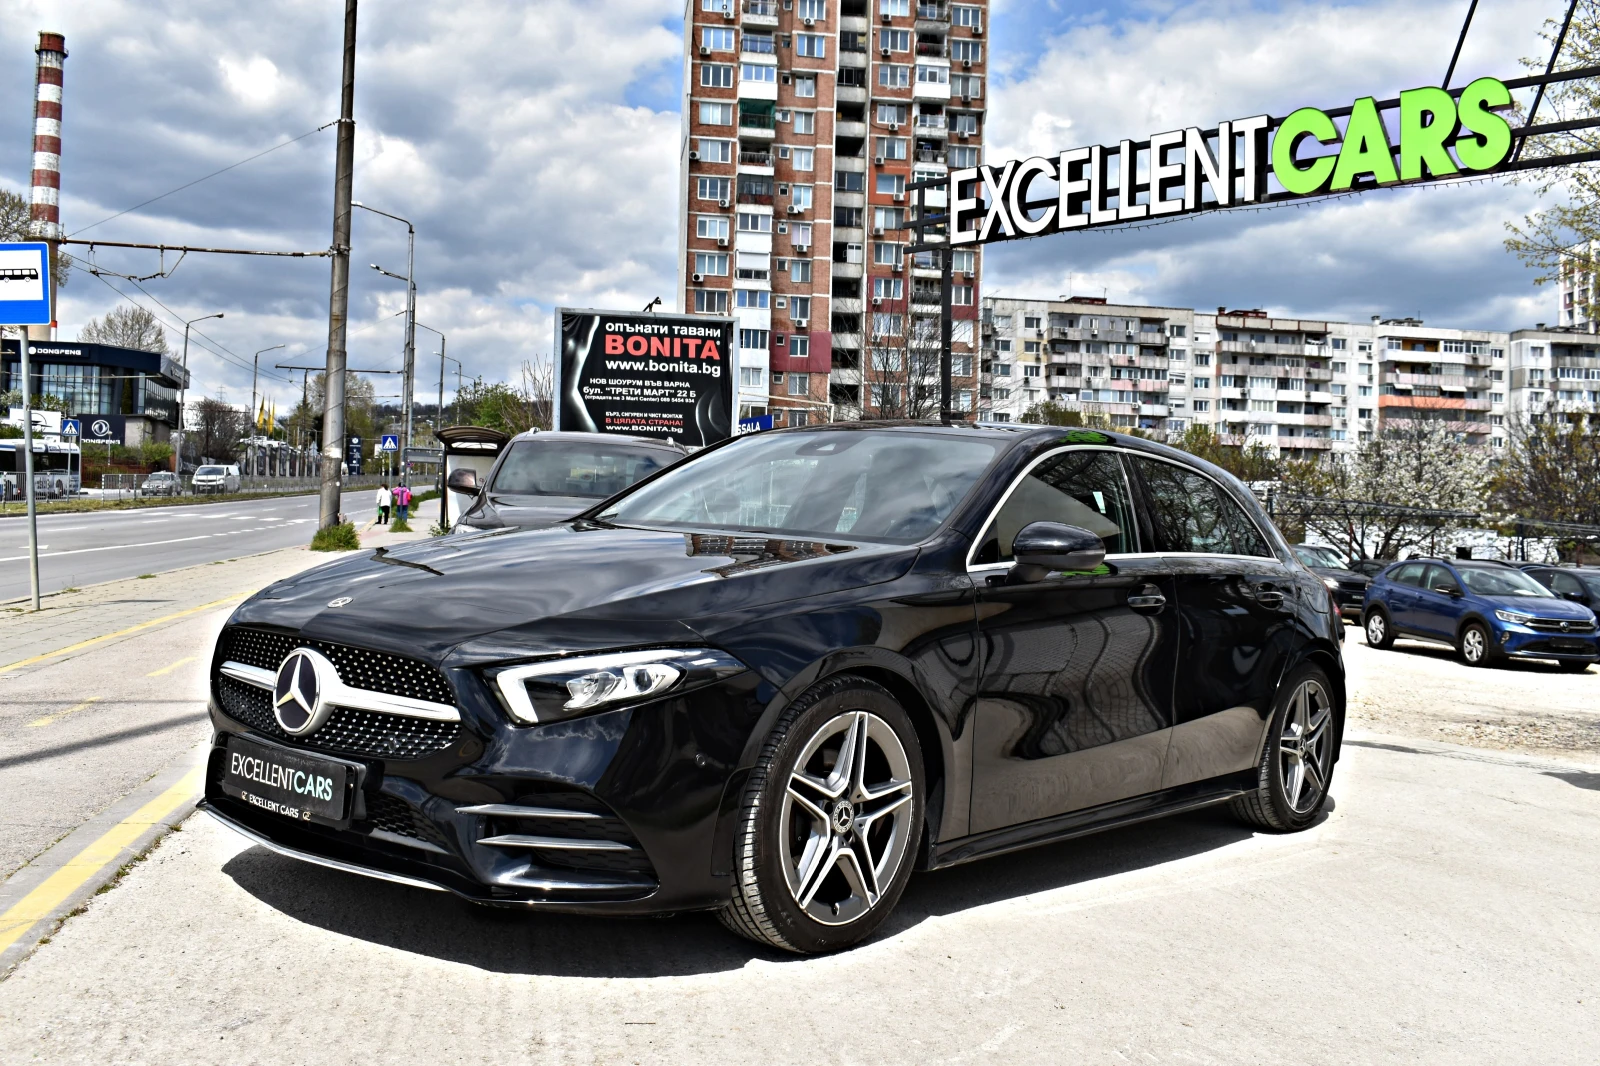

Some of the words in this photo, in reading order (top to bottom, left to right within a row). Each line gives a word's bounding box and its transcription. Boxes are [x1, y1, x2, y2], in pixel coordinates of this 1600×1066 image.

[605, 322, 668, 335] опънати
[672, 325, 720, 337] тавани
[37, 348, 82, 356] DONGFENG
[605, 334, 720, 360] BONITA
[605, 360, 720, 377] www.bonita.bg
[589, 377, 607, 385] НОВ
[608, 378, 643, 387] ШОУРУМ
[644, 380, 663, 388] ВЪВ
[663, 380, 691, 389] ВАРНА
[676, 390, 688, 398] 22
[605, 425, 684, 434] www.BONITA.bg
[249, 794, 280, 812] EXCELLENT
[280, 805, 299, 819] CARS
